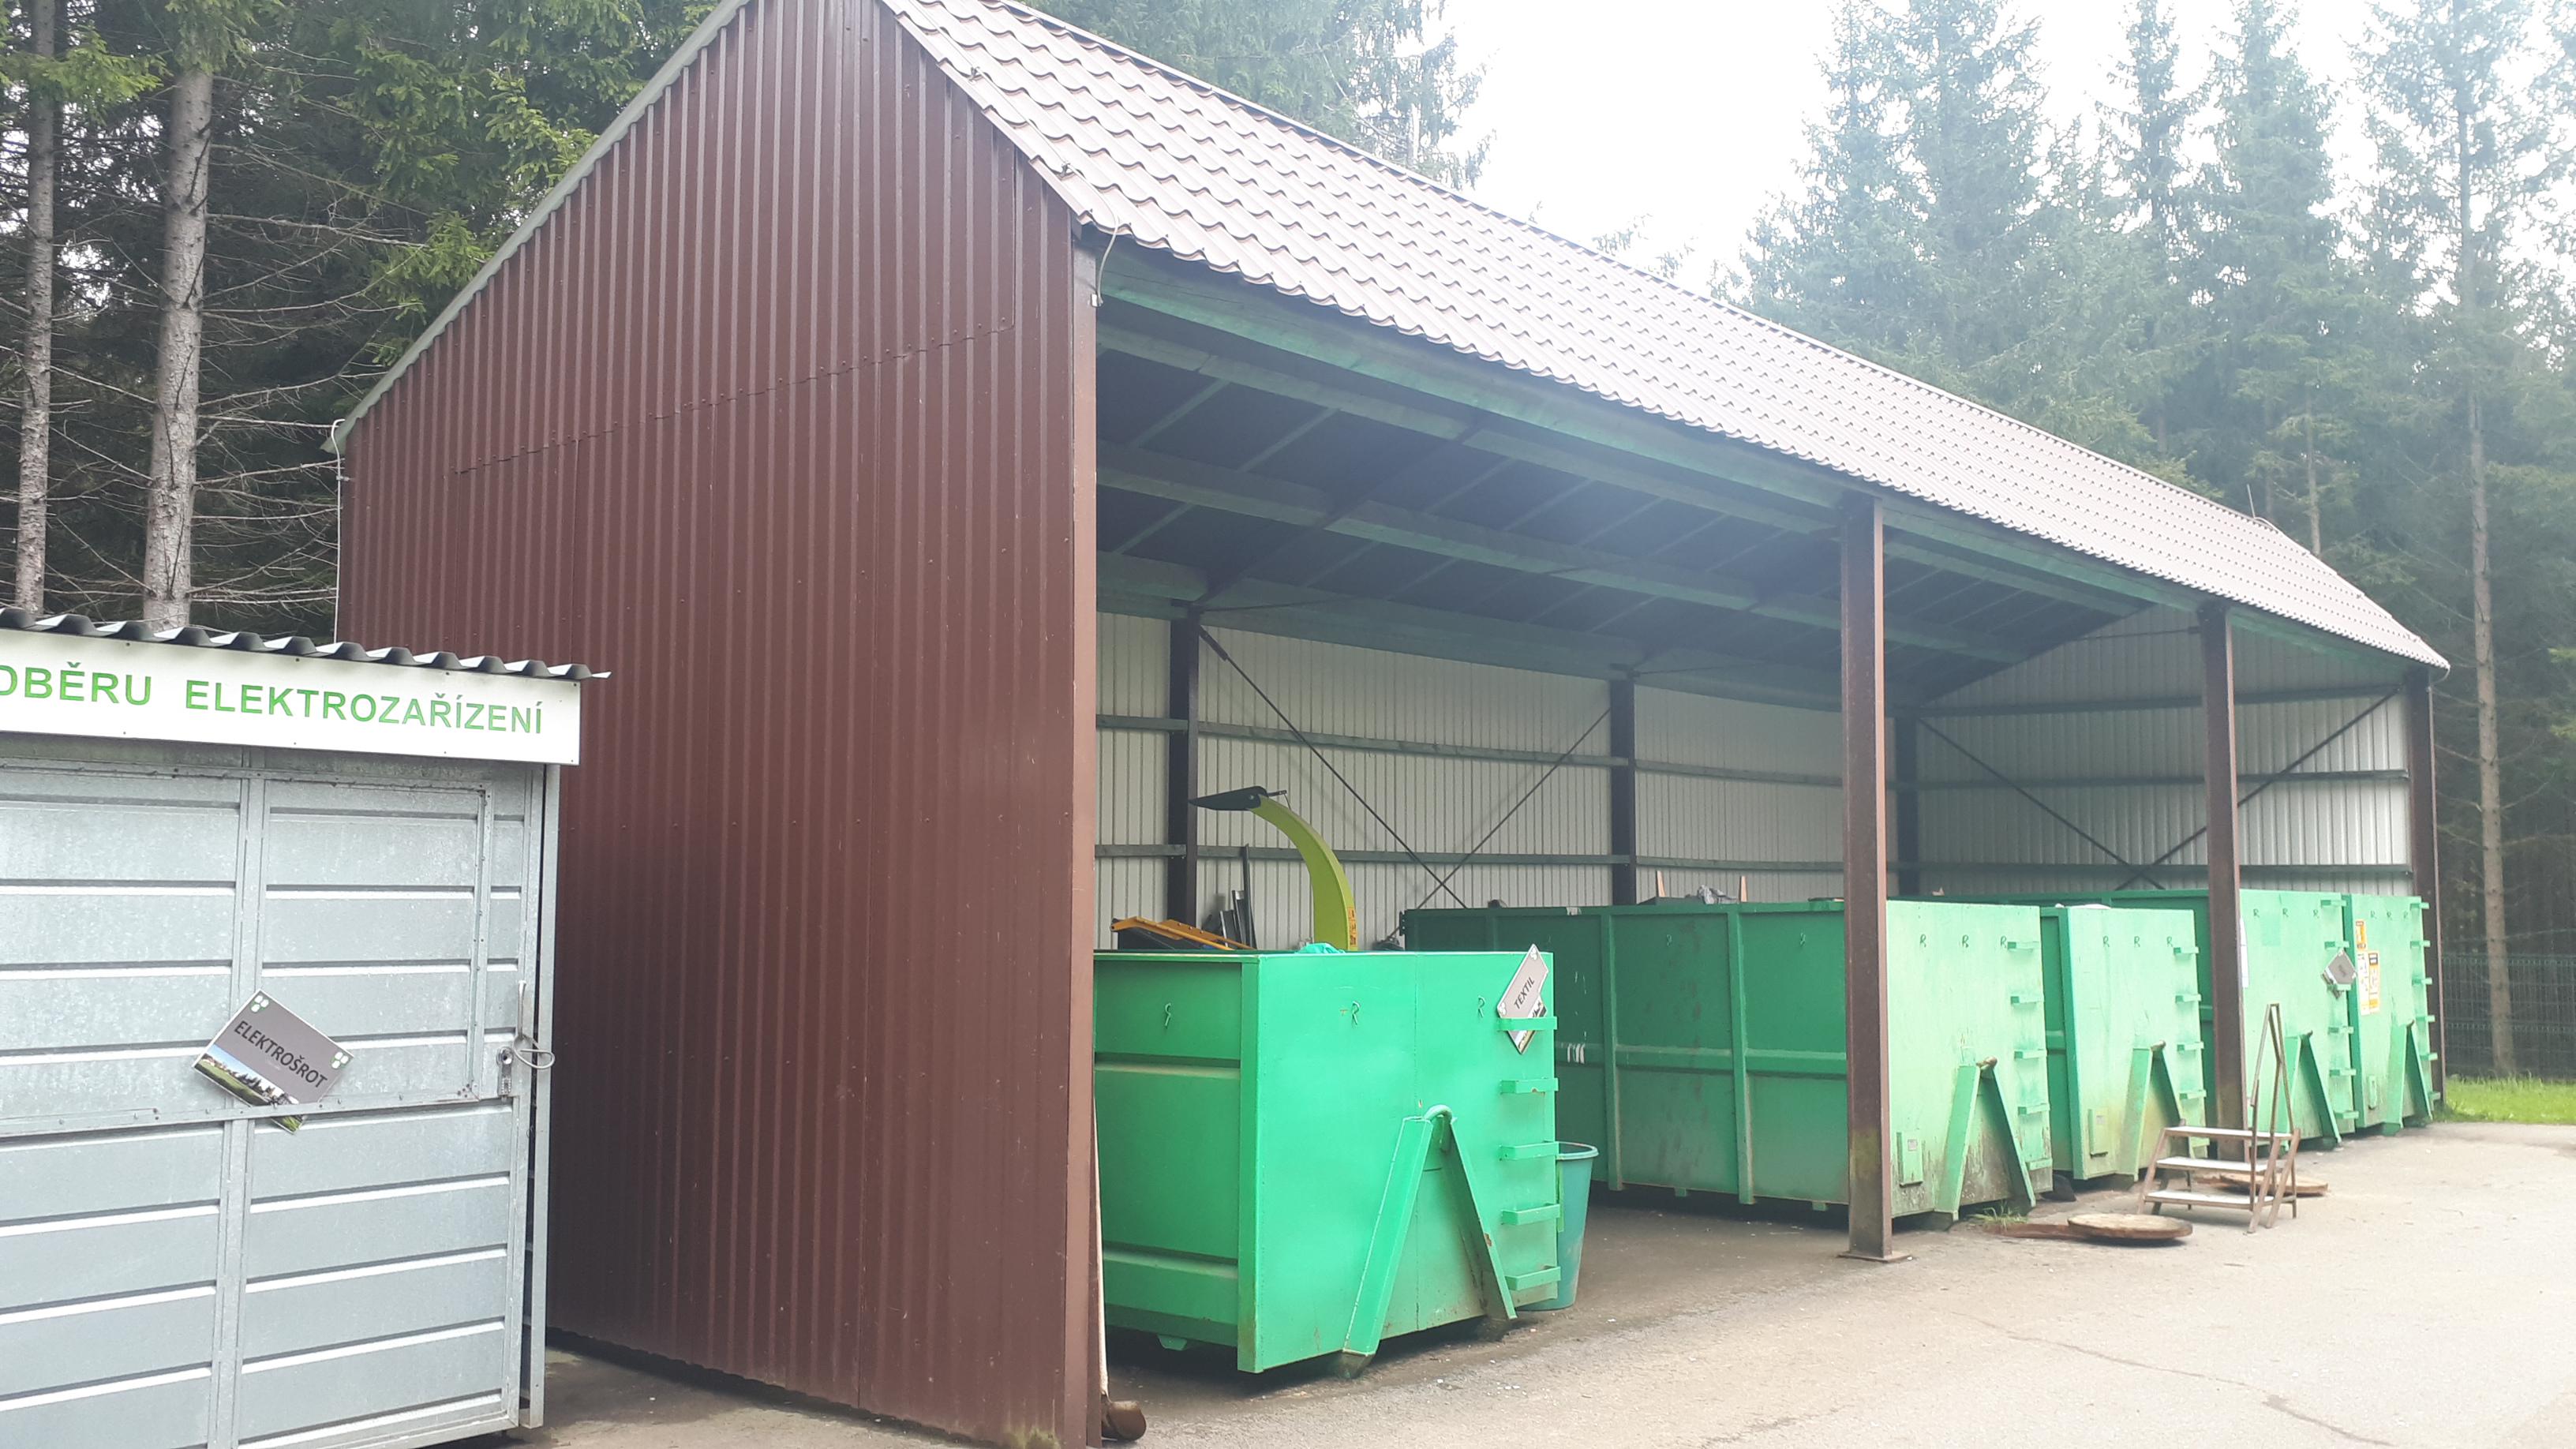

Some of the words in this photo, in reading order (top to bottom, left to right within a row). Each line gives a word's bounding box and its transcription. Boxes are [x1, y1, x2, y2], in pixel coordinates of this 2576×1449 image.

[185, 680, 543, 734] ELEKTROZAŘÍZENÍ
[1514, 976, 1535, 1009] TEXTIL
[234, 1020, 328, 1088] ELEKTROŠROT
